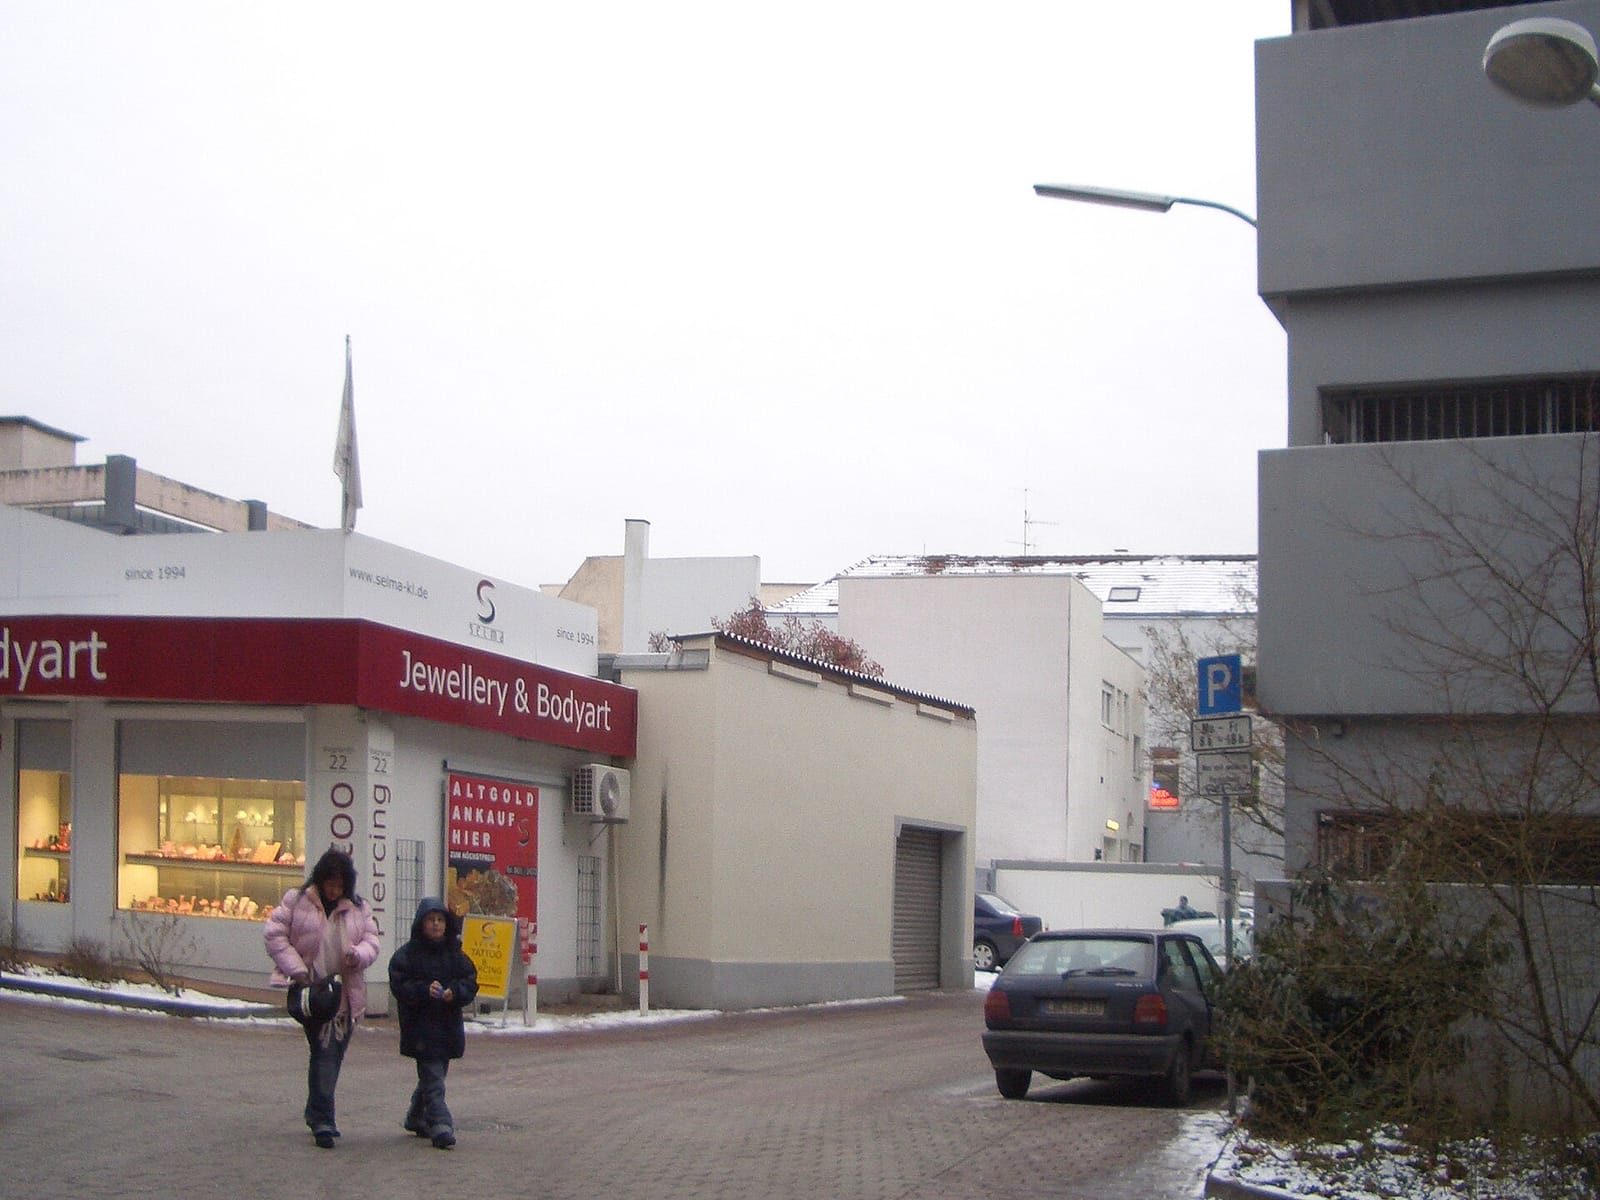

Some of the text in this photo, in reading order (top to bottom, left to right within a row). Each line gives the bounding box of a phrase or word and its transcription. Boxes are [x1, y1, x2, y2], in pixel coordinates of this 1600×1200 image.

[125, 566, 186, 580] since 1994
[556, 627, 594, 645] since 1994
[400, 650, 612, 733] Jewellery & Bodyart
[1208, 663, 1231, 707] P
[329, 754, 347, 770] 22
[452, 780, 535, 807] ALTGOLD
[452, 805, 515, 827] ANKAUF
[452, 829, 491, 848] HIER
